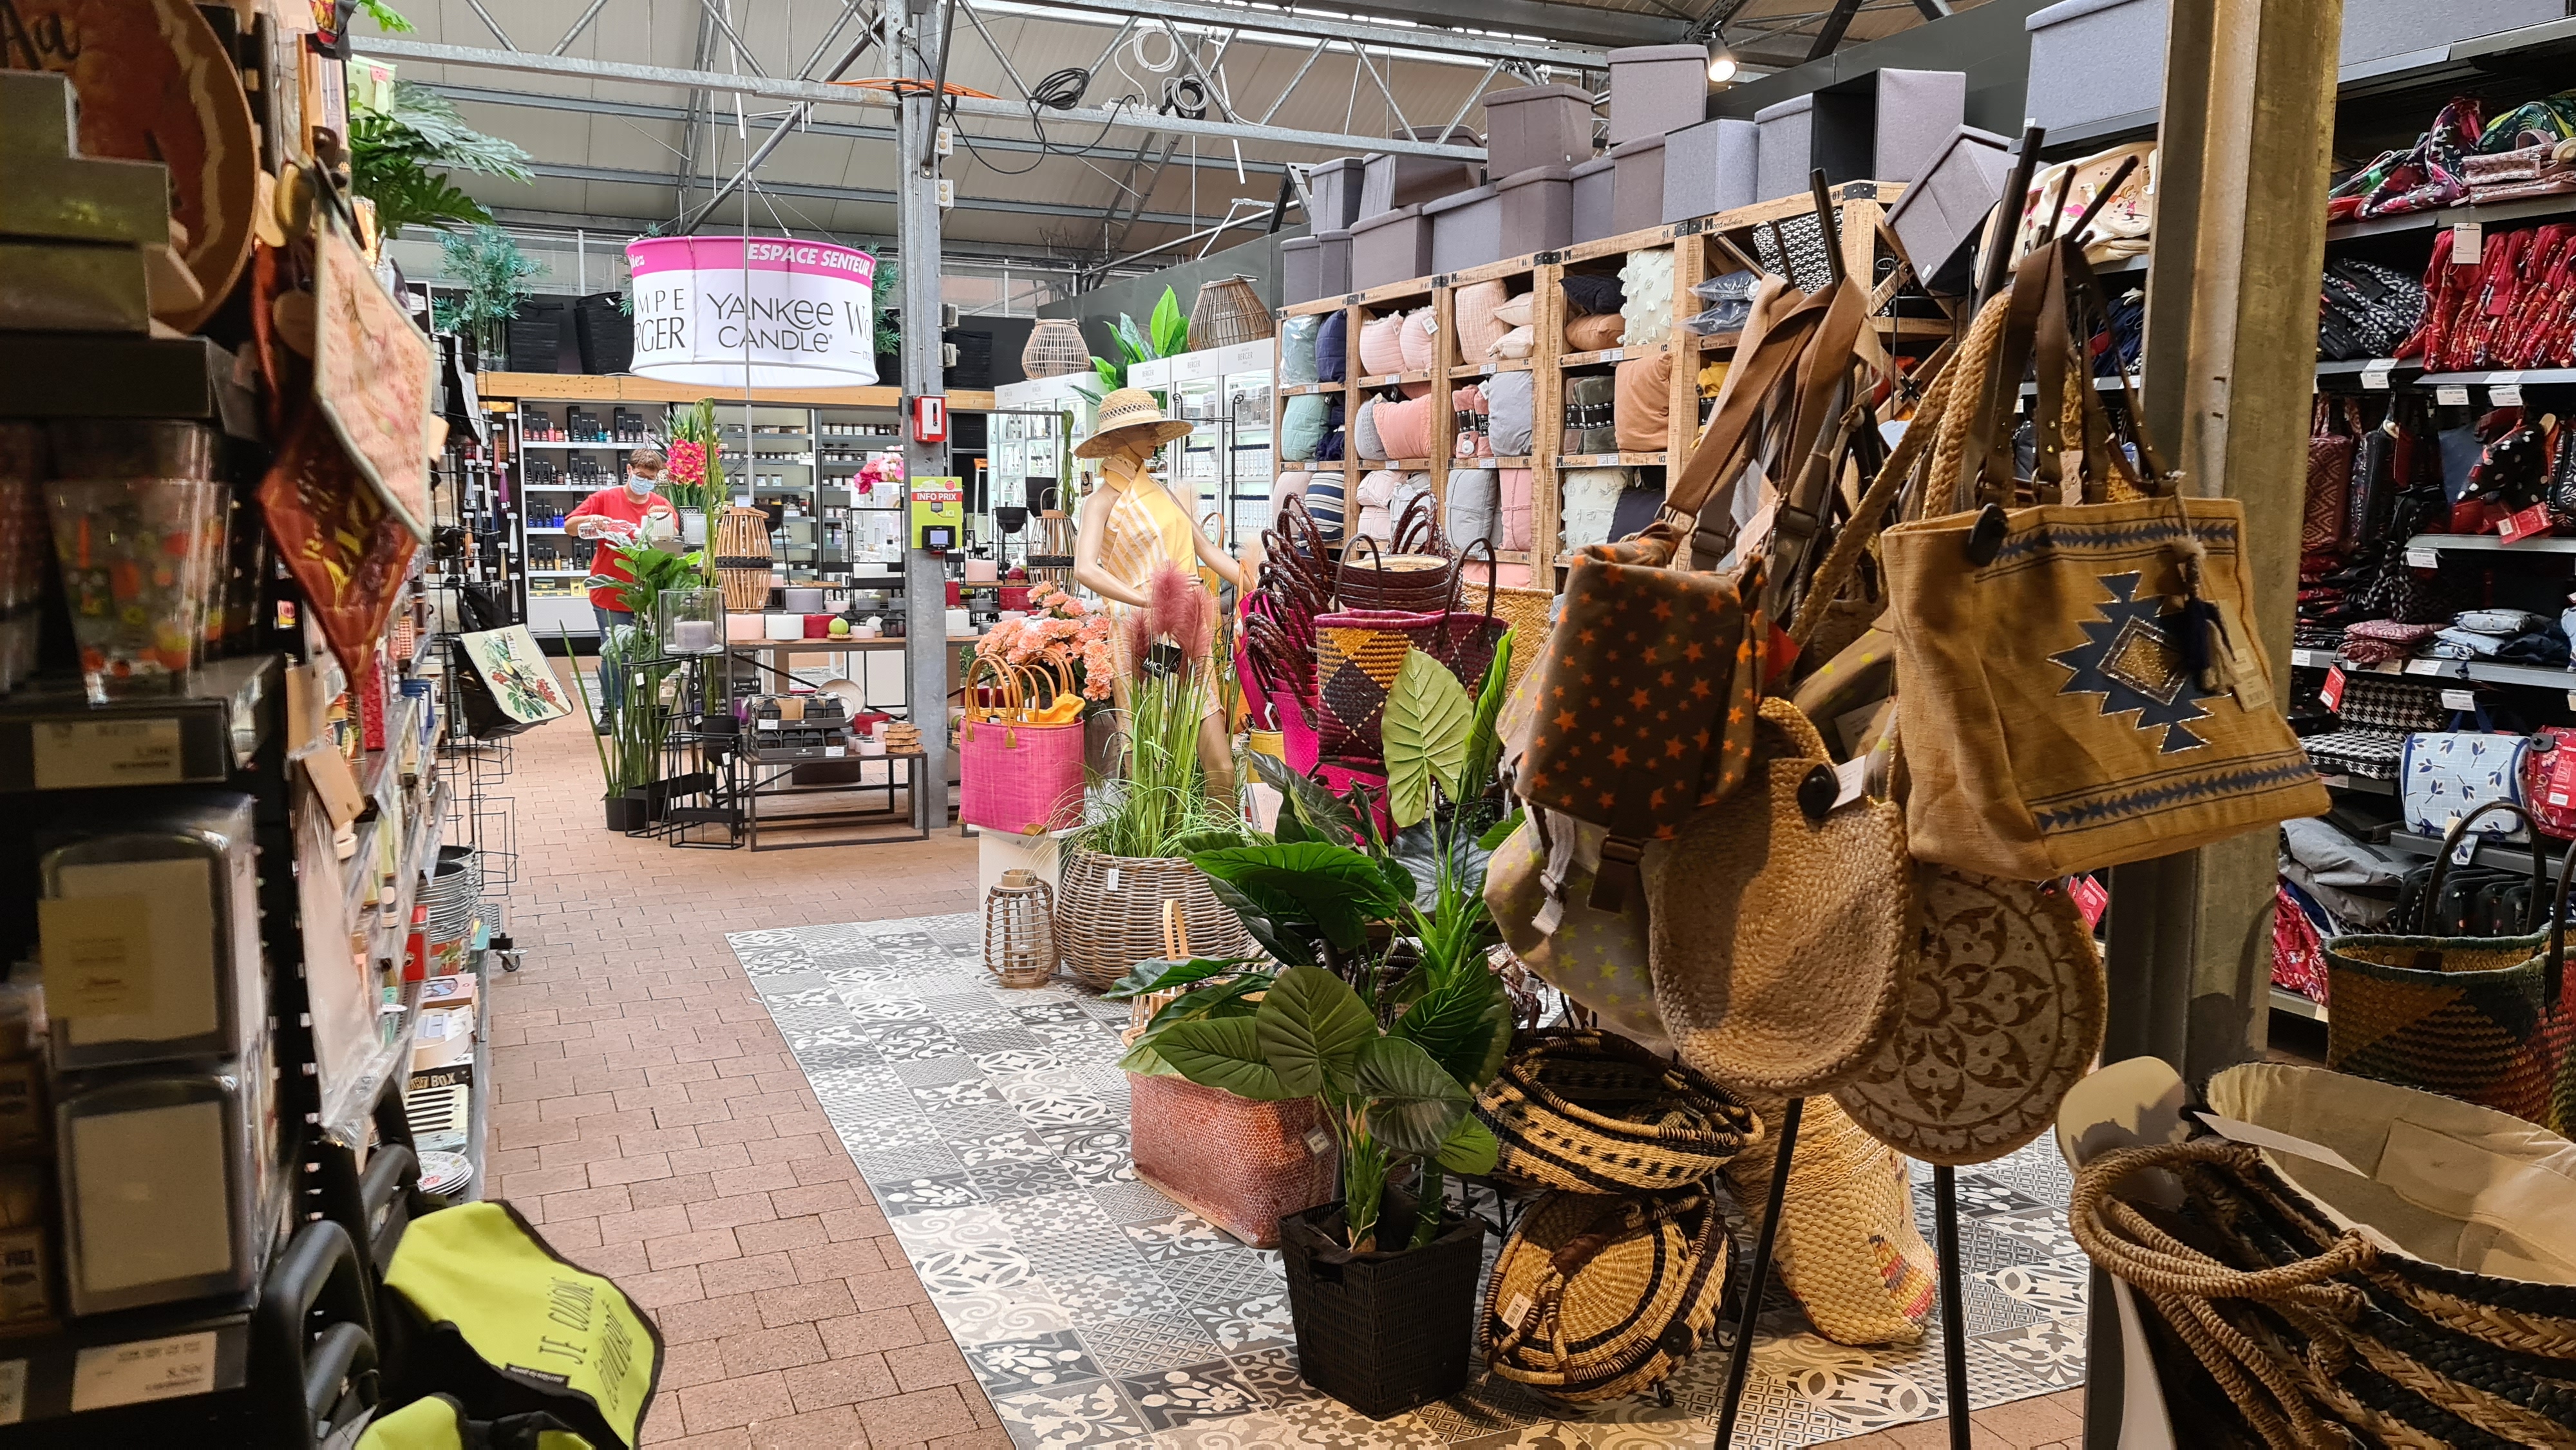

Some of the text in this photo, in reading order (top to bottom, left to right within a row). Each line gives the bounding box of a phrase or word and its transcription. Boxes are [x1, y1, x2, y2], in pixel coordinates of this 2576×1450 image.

[748, 243, 819, 265] ESPACE
[1238, 352, 1253, 361] BERGER
[1658, 455, 1667, 464] 03
[916, 493, 957, 501] INFO PRIX
[430, 1072, 457, 1088] BOX
